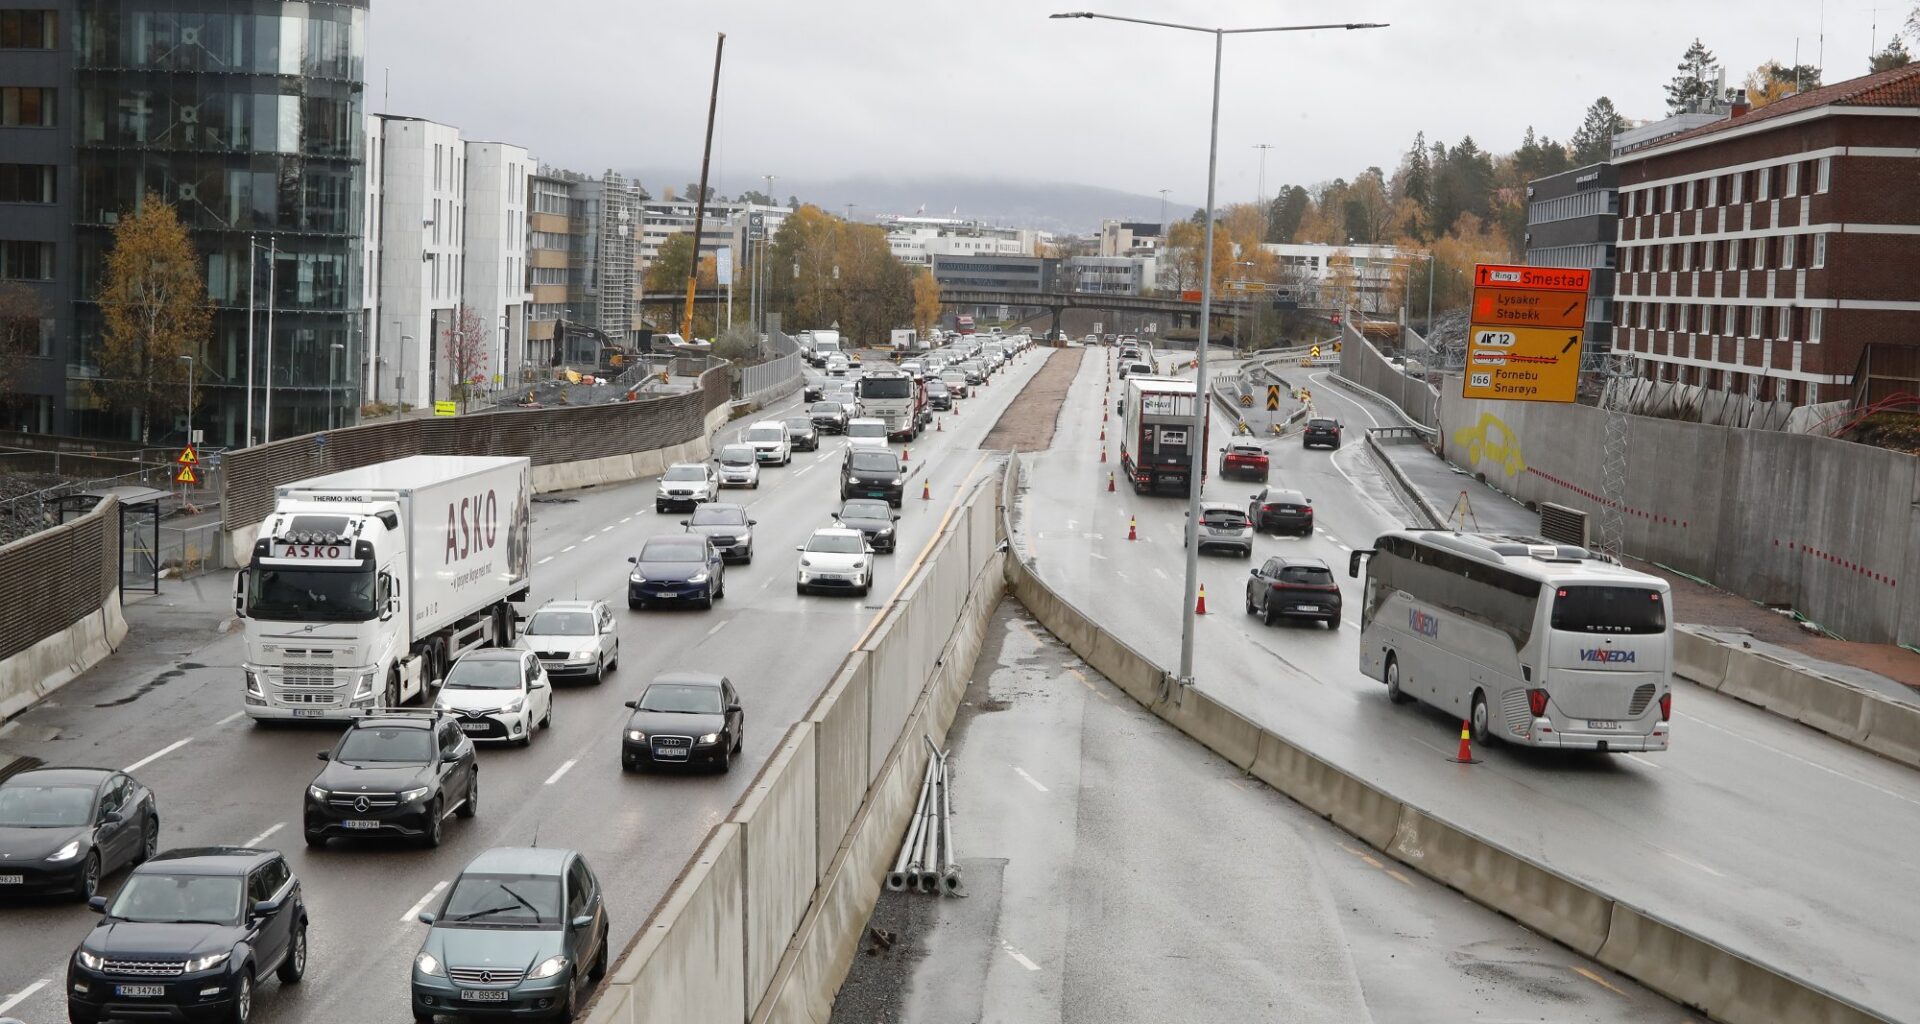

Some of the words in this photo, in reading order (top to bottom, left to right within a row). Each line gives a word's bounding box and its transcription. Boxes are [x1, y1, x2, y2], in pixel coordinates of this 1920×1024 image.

[1495, 272, 1512, 280] Ring
[1522, 271, 1584, 287] Smestad
[1497, 293, 1540, 306] Lysaker
[1496, 308, 1540, 320] Stabekk
[1499, 333, 1510, 345] 12
[1472, 375, 1489, 385] 166
[1495, 369, 1538, 380] Fornebu
[1494, 382, 1537, 396] Snarøya
[445, 489, 497, 565] ASKO
[285, 545, 340, 559] ASKO
[122, 986, 133, 994] ZH
[137, 986, 163, 995] 34768
[463, 990, 474, 999] AX
[479, 991, 506, 1000] 89351
